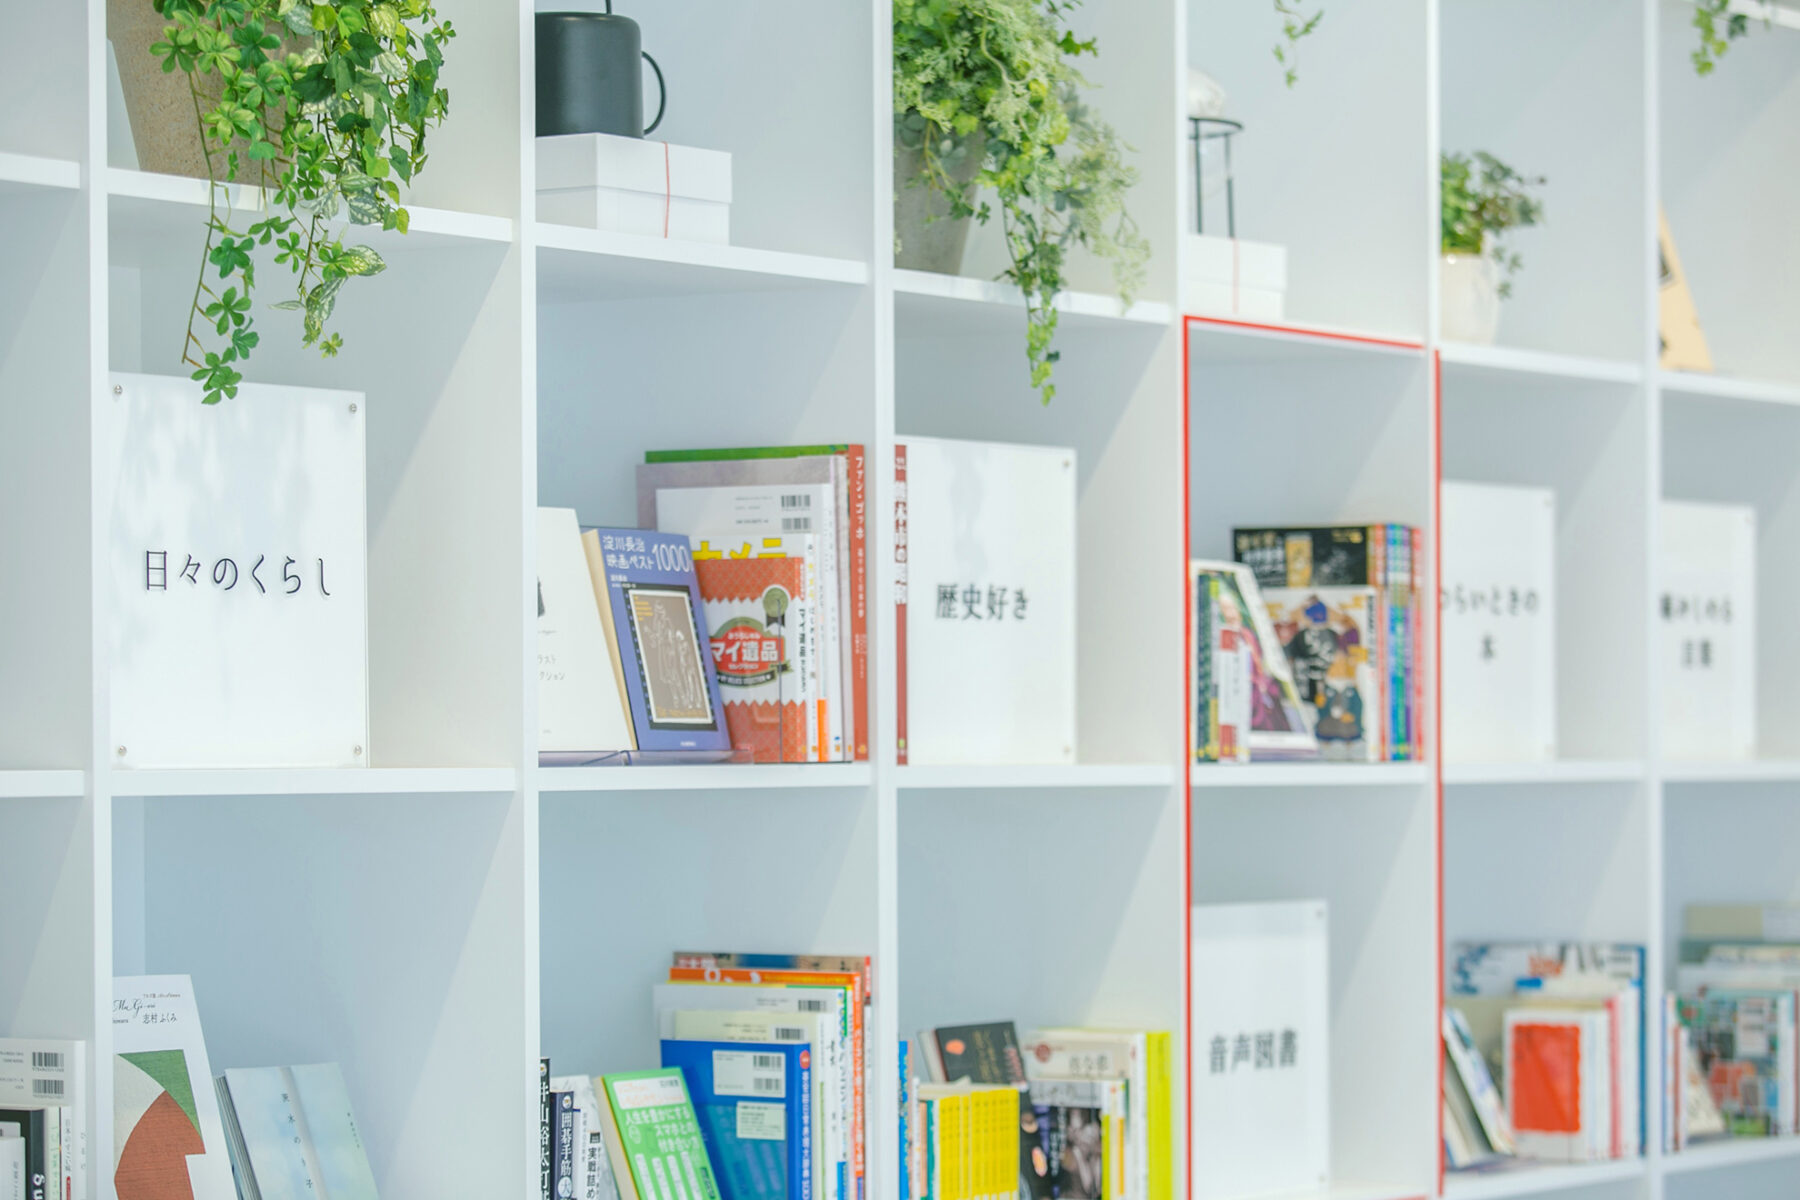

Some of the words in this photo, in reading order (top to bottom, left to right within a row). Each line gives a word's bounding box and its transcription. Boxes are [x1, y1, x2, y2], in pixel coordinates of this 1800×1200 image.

[145, 550, 331, 597] 日々のくらし
[651, 544, 690, 572] 1000
[936, 583, 1029, 621] 歴史好き
[711, 640, 778, 662] マイ遺品
